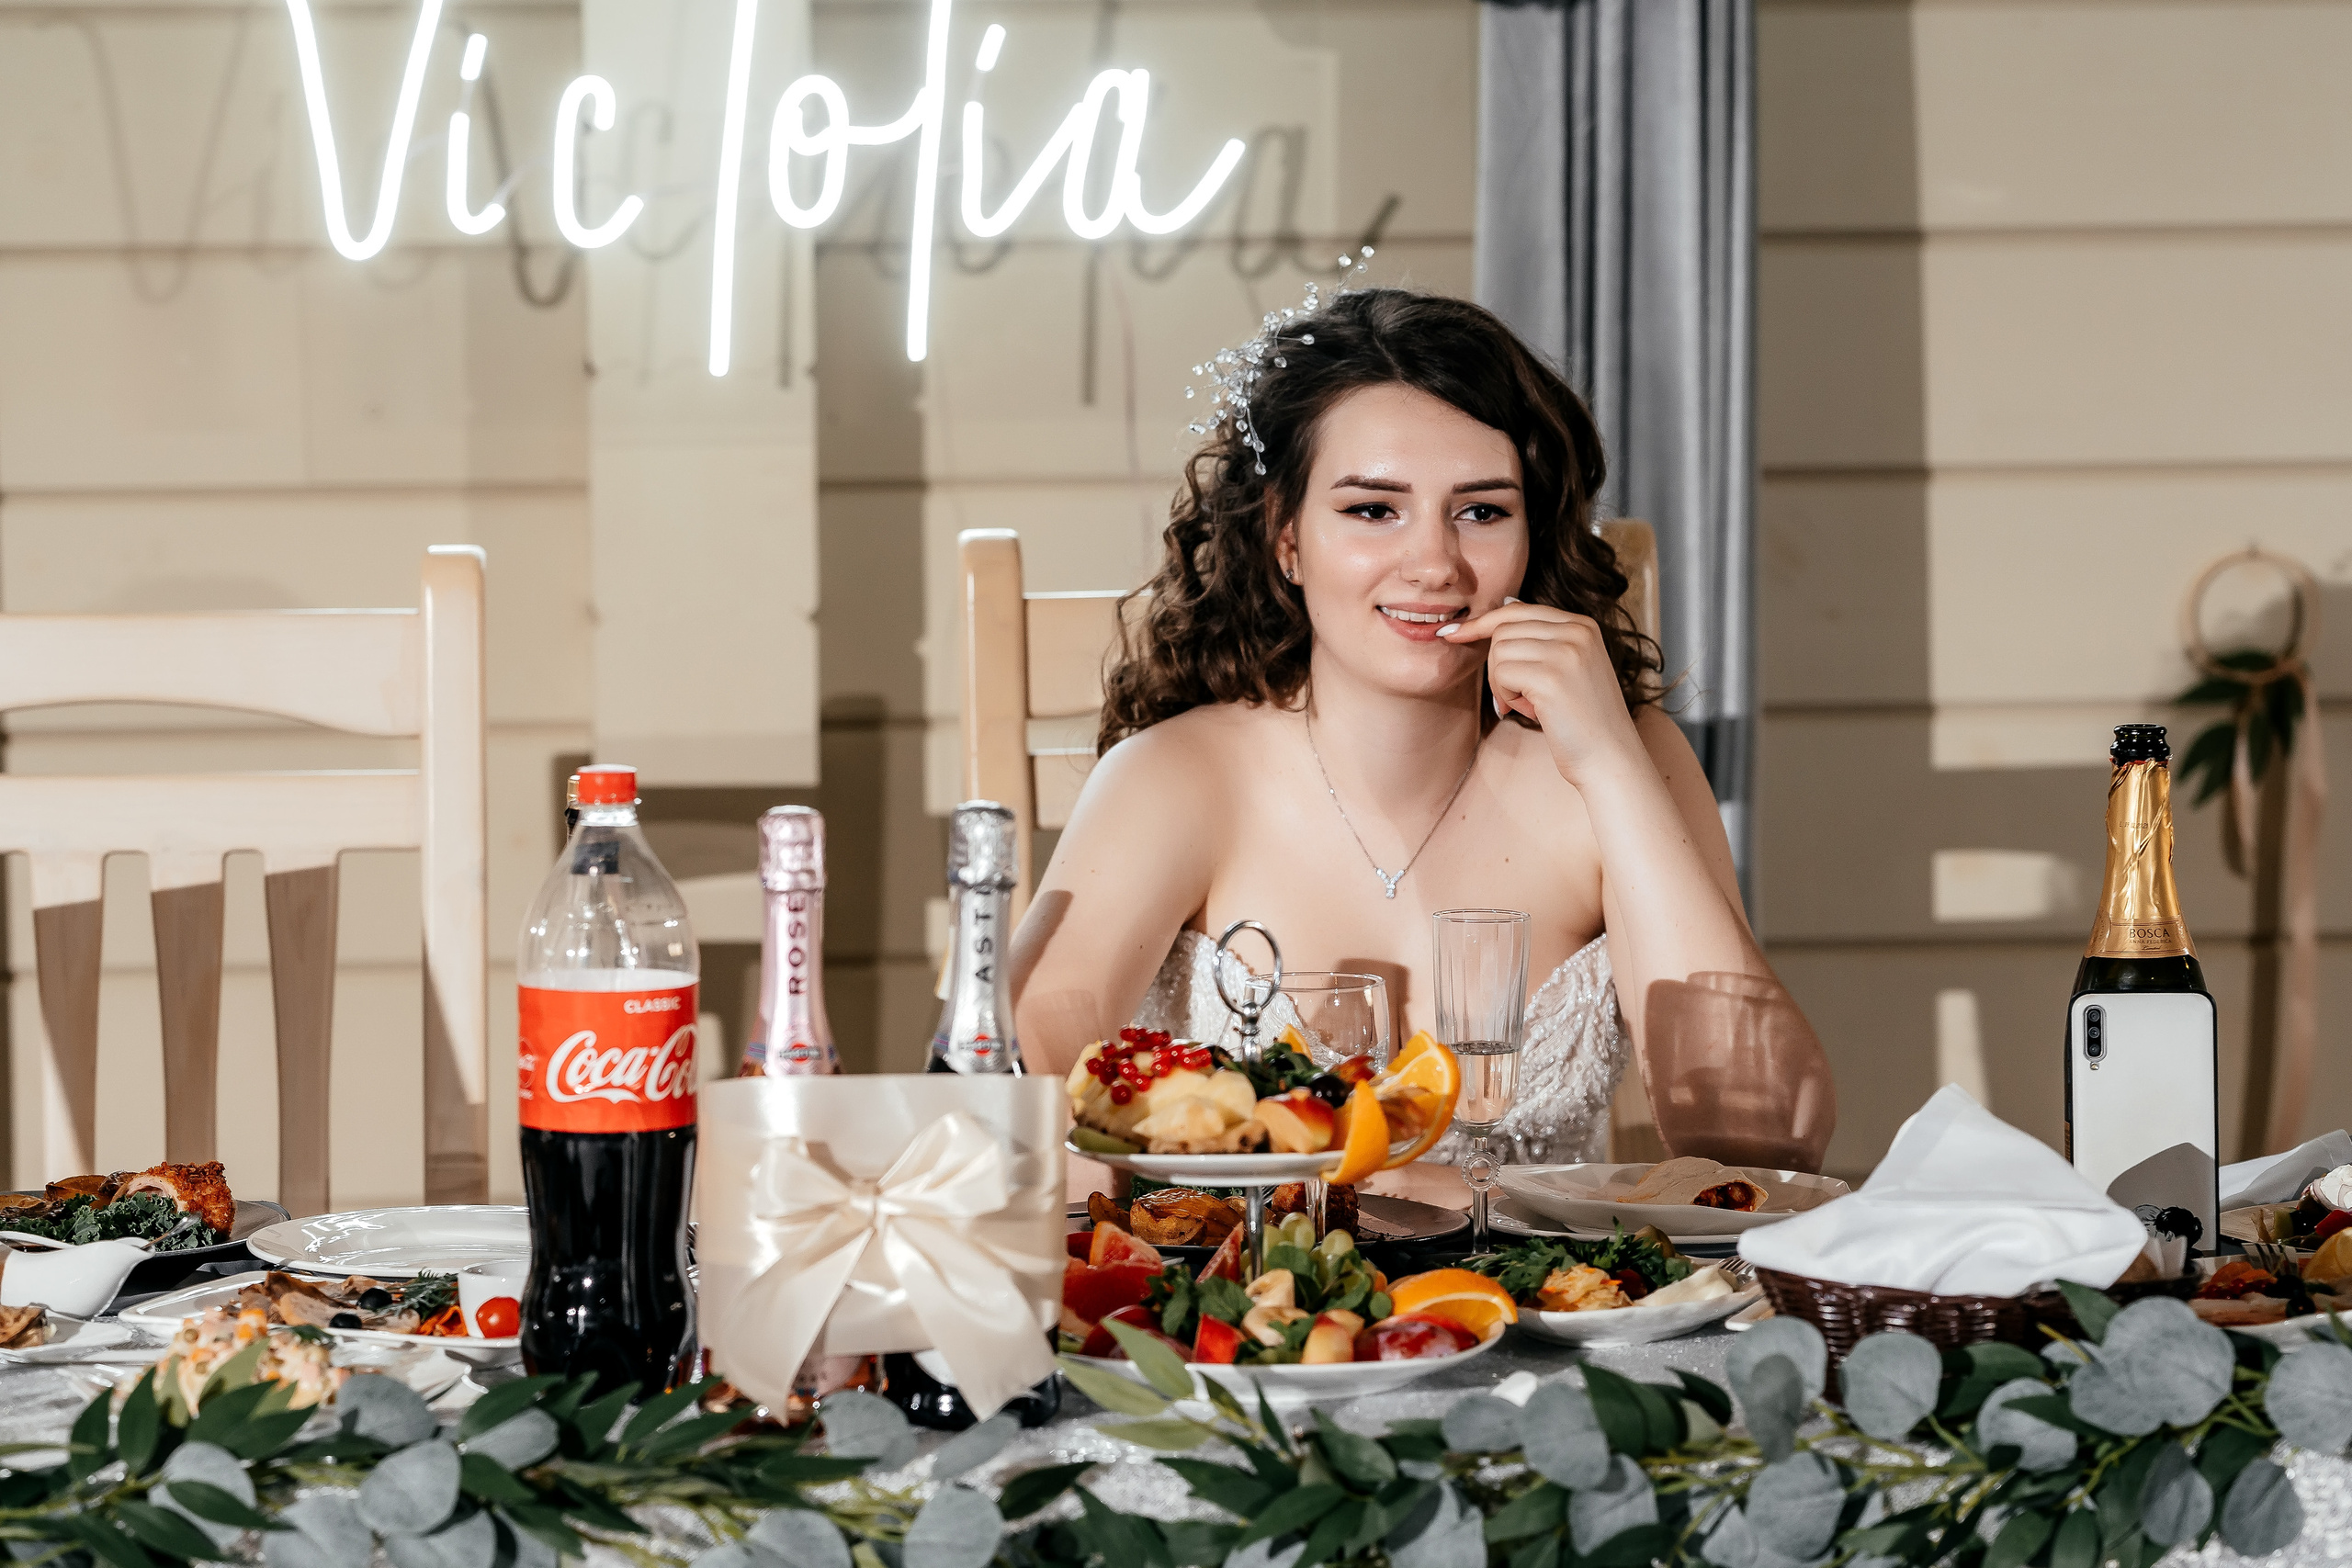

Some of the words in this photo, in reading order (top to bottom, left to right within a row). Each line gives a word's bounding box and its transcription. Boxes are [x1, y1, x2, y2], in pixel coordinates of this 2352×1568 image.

[2129, 928, 2171, 939] BOSCA
[623, 996, 682, 1015] CLASSIC
[546, 1022, 698, 1104] Coca-Col
